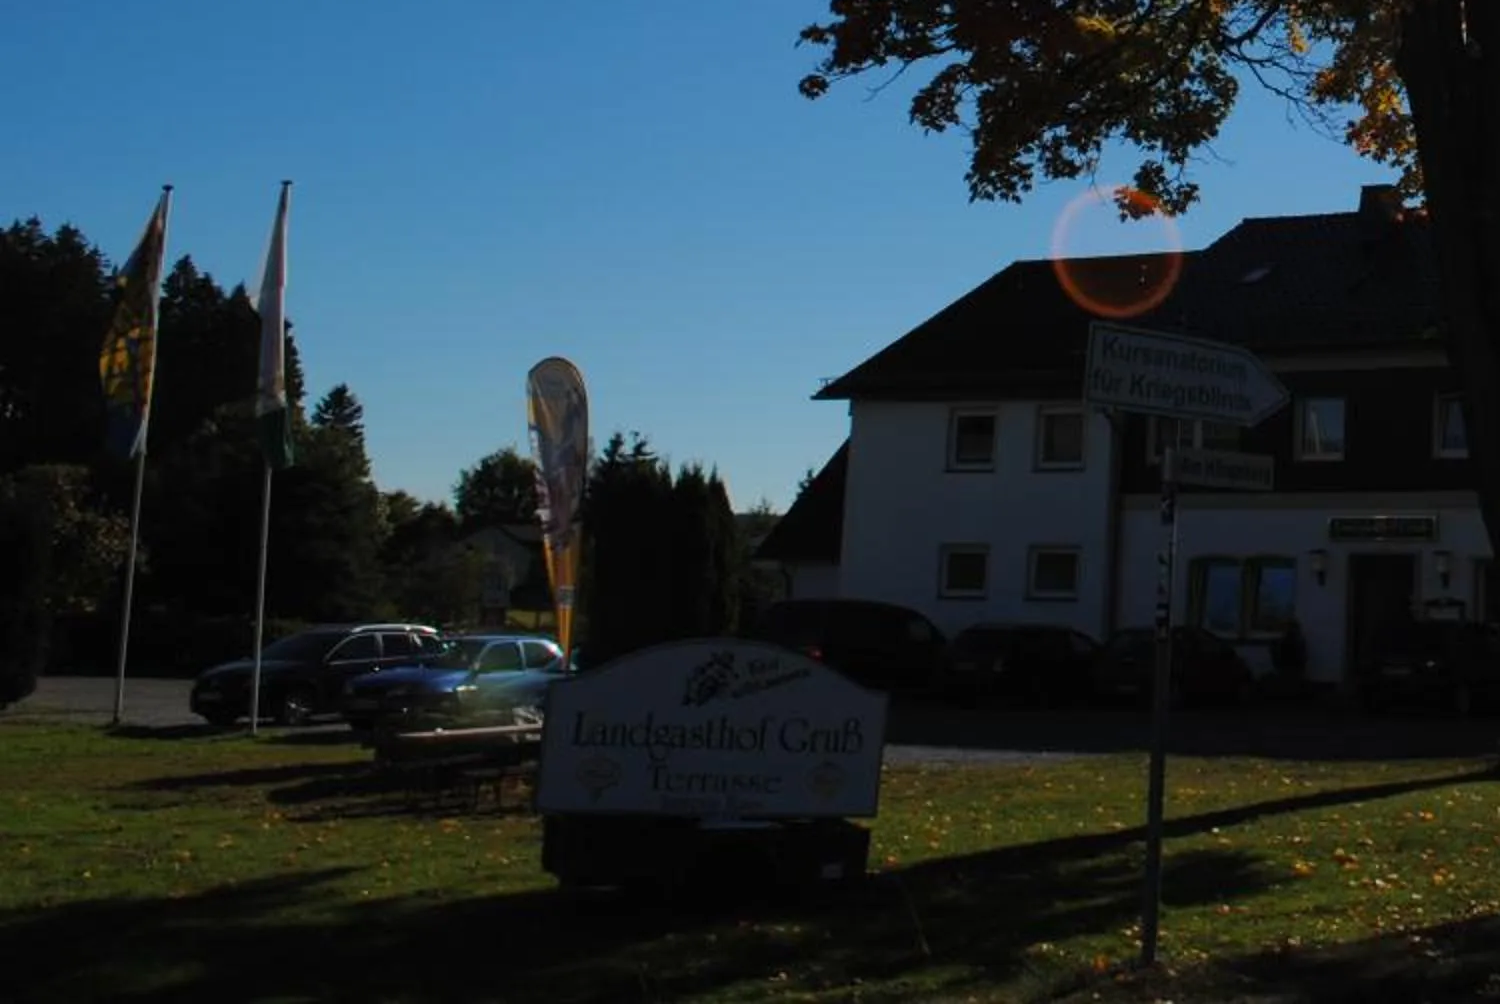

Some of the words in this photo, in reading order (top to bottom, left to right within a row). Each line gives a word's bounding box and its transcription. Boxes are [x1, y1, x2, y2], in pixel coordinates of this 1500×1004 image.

[1101, 335, 1248, 381] Kursanatorium
[1092, 367, 1123, 394] für
[572, 710, 774, 762] Landgasthof
[779, 716, 865, 754] Gruß
[647, 764, 783, 794] Terrasse
